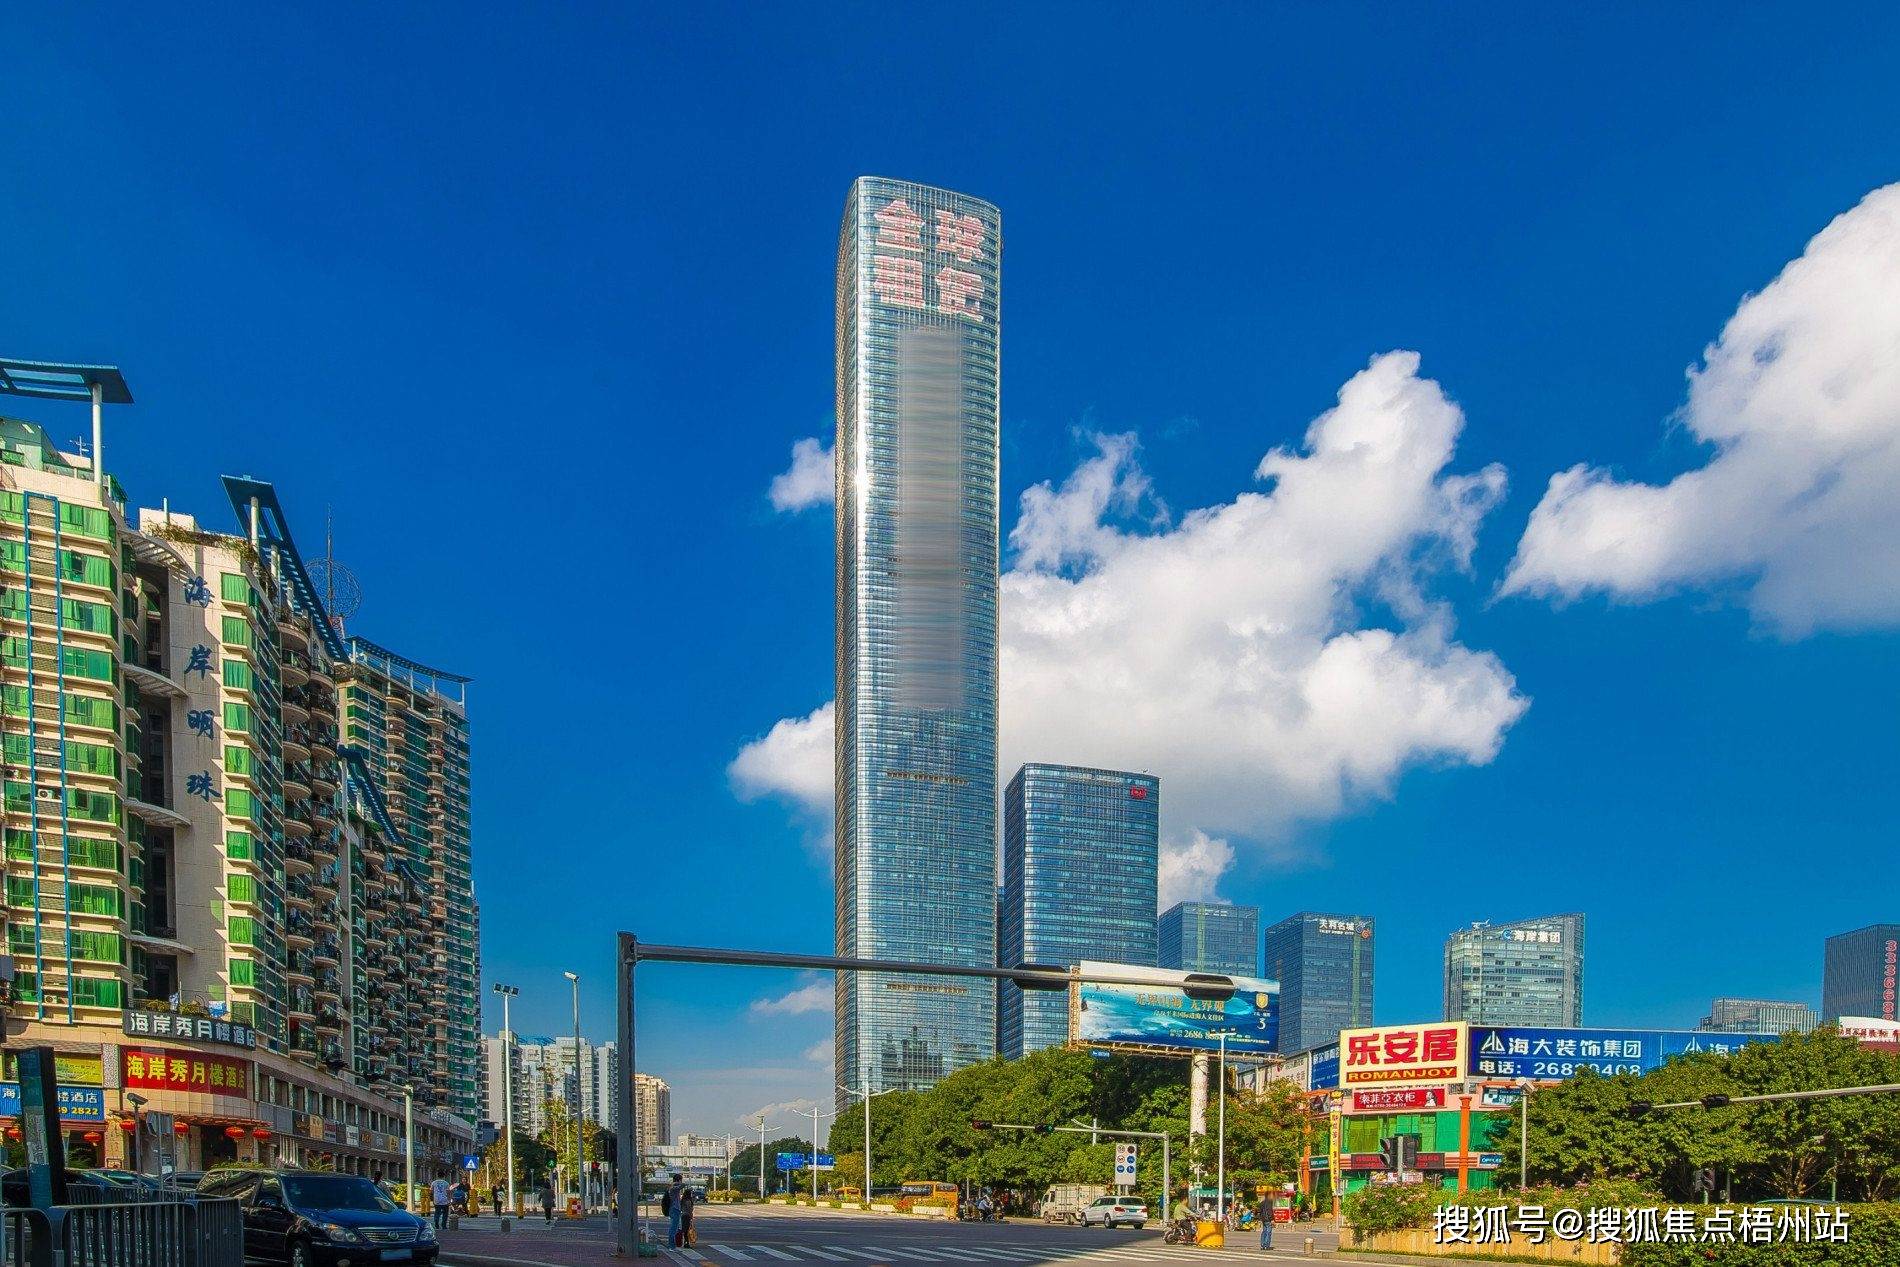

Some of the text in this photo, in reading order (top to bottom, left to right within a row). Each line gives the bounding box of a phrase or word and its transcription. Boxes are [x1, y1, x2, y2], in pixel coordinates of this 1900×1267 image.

[184, 575, 222, 802] 海岸明珠
[1513, 930, 1561, 943] 海岸集团
[130, 1012, 256, 1048] 海岸秀月楼酒店
[1347, 1029, 1458, 1066] 乐安居
[1508, 1038, 1642, 1058] 海大装饰集团
[127, 1055, 245, 1089] 海岸秀月楼酒店
[1348, 1067, 1455, 1081] ROMANJOY
[71, 1106, 98, 1115] 2822
